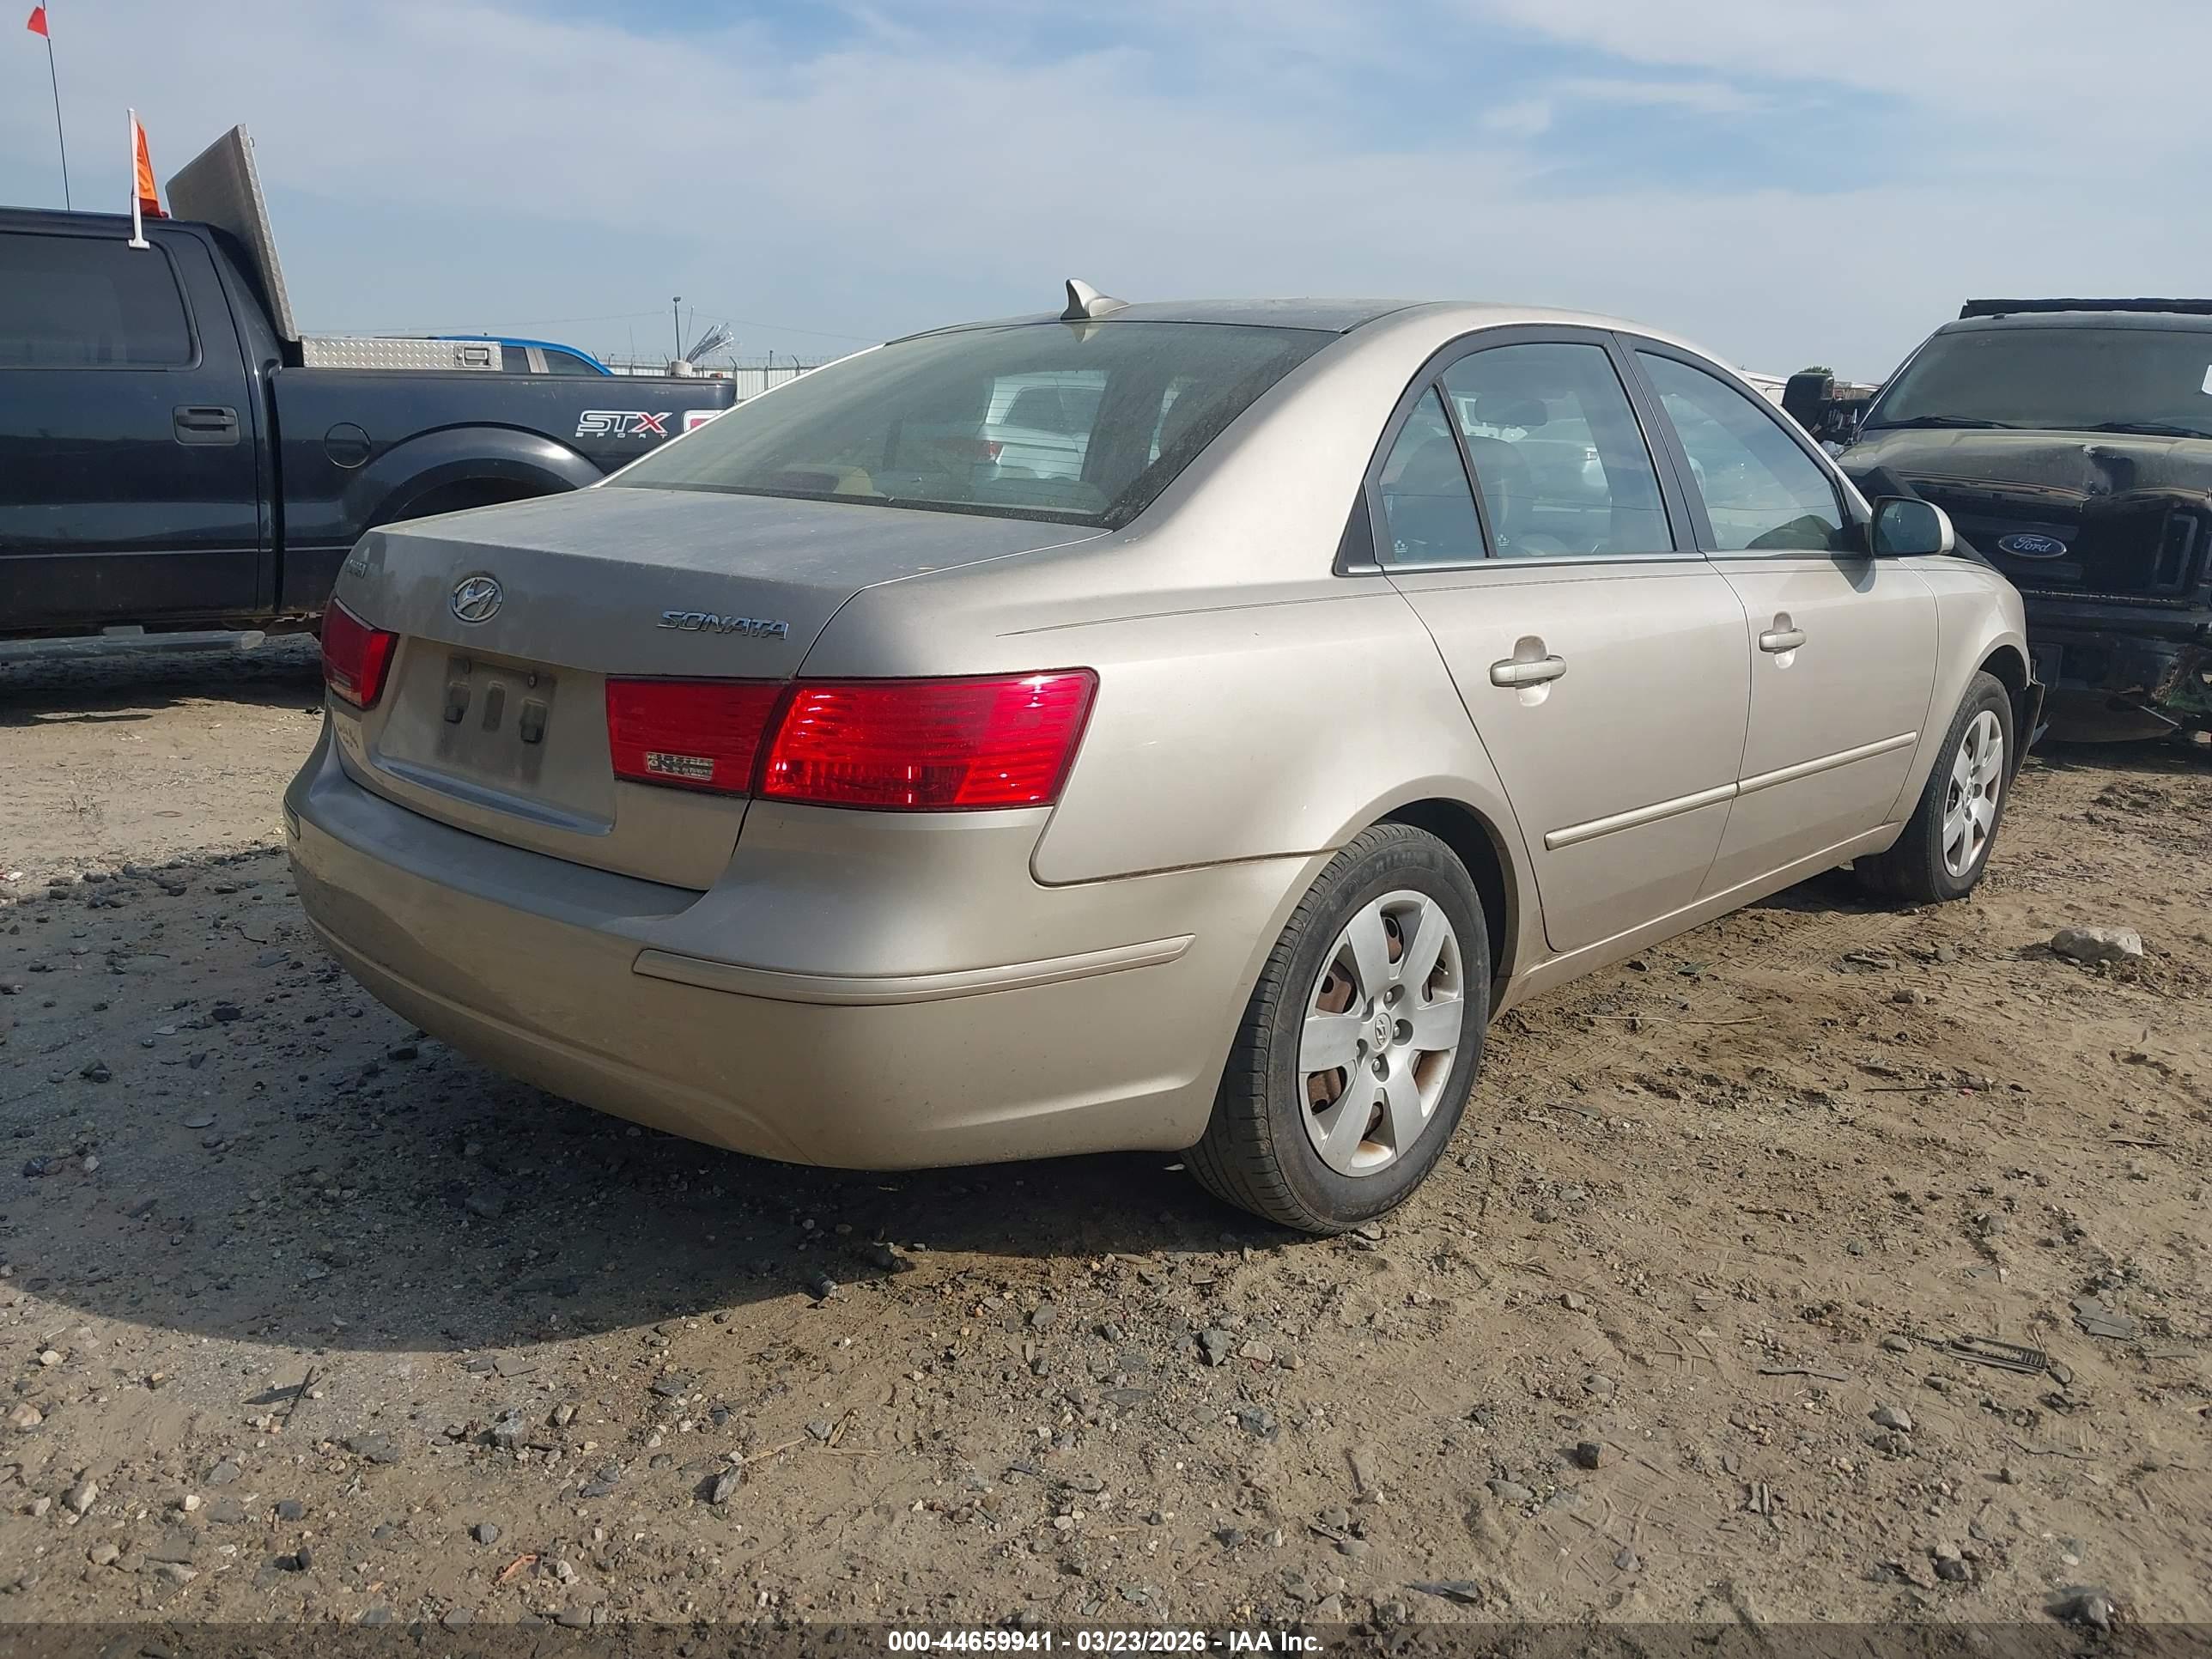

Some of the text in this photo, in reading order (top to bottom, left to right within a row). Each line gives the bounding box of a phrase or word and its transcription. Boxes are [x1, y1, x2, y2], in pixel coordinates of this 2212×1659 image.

[577, 410, 673, 433] STX
[2013, 537, 2051, 552] Ford
[656, 611, 789, 640] SONATA
